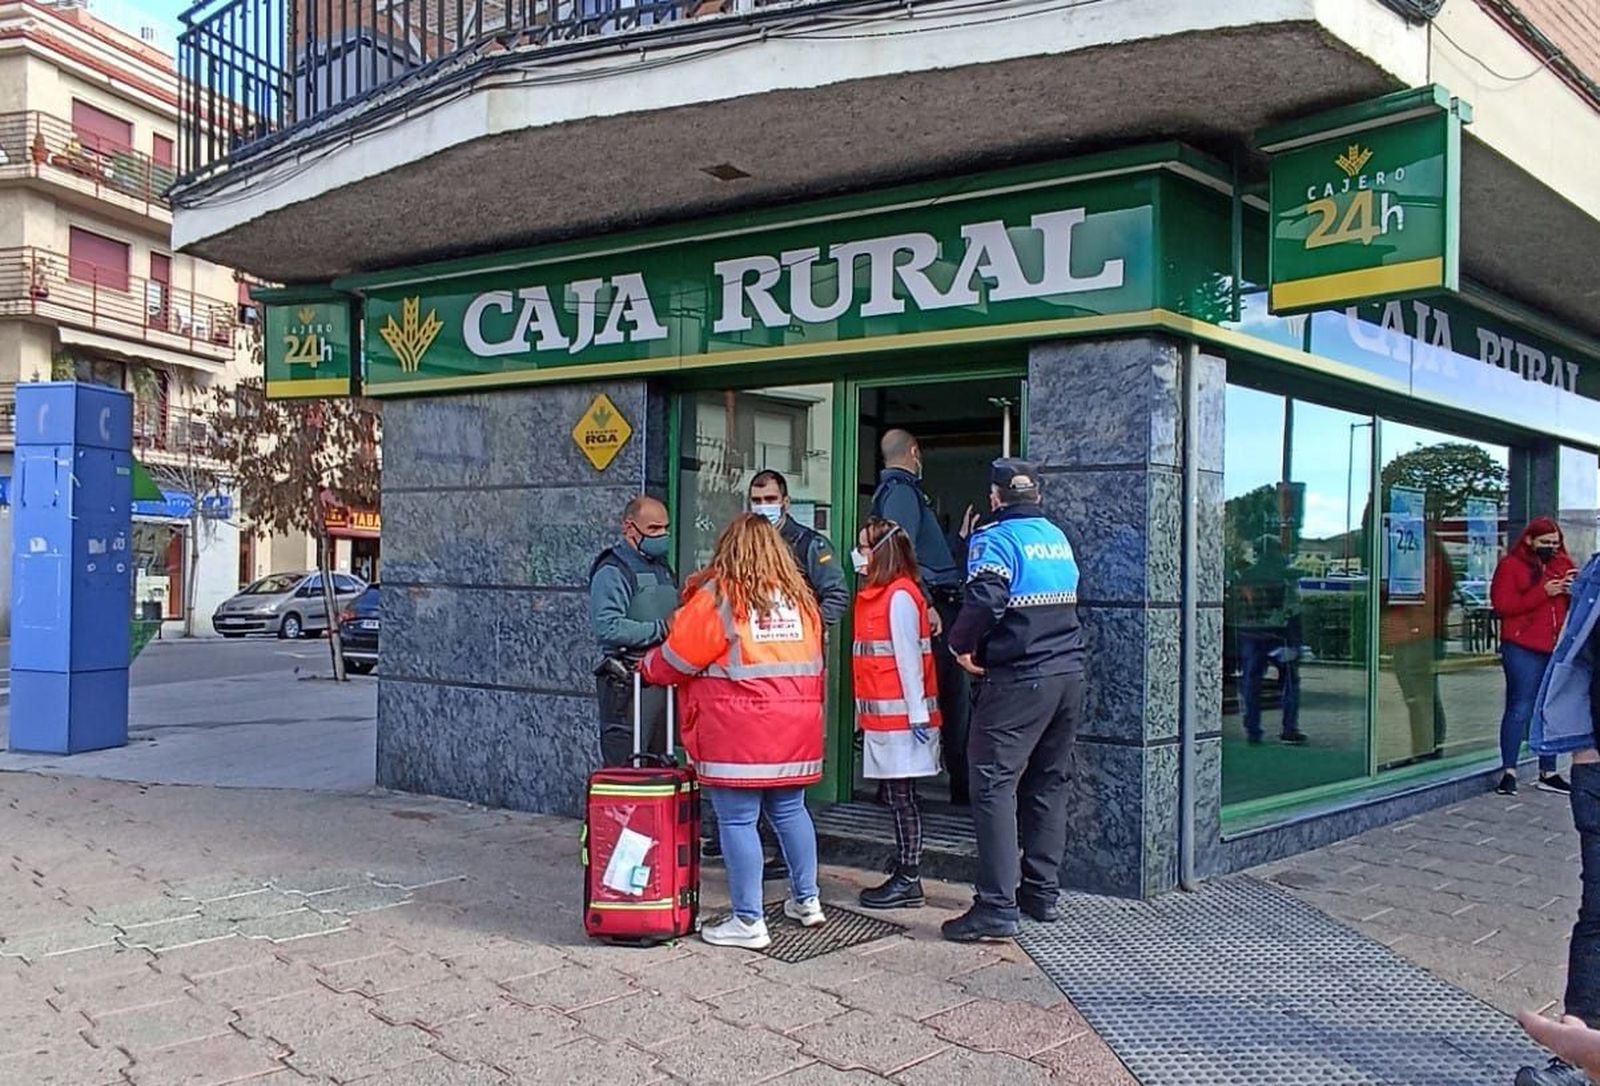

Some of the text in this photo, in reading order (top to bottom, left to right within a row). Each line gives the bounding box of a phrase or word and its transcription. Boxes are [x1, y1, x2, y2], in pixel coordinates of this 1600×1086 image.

[1306, 167, 1405, 200] CAJERO
[1305, 189, 1404, 249] 24h
[462, 207, 1124, 357] CAJA RURAL
[283, 333, 333, 368] 24h
[585, 434, 618, 445] RGA
